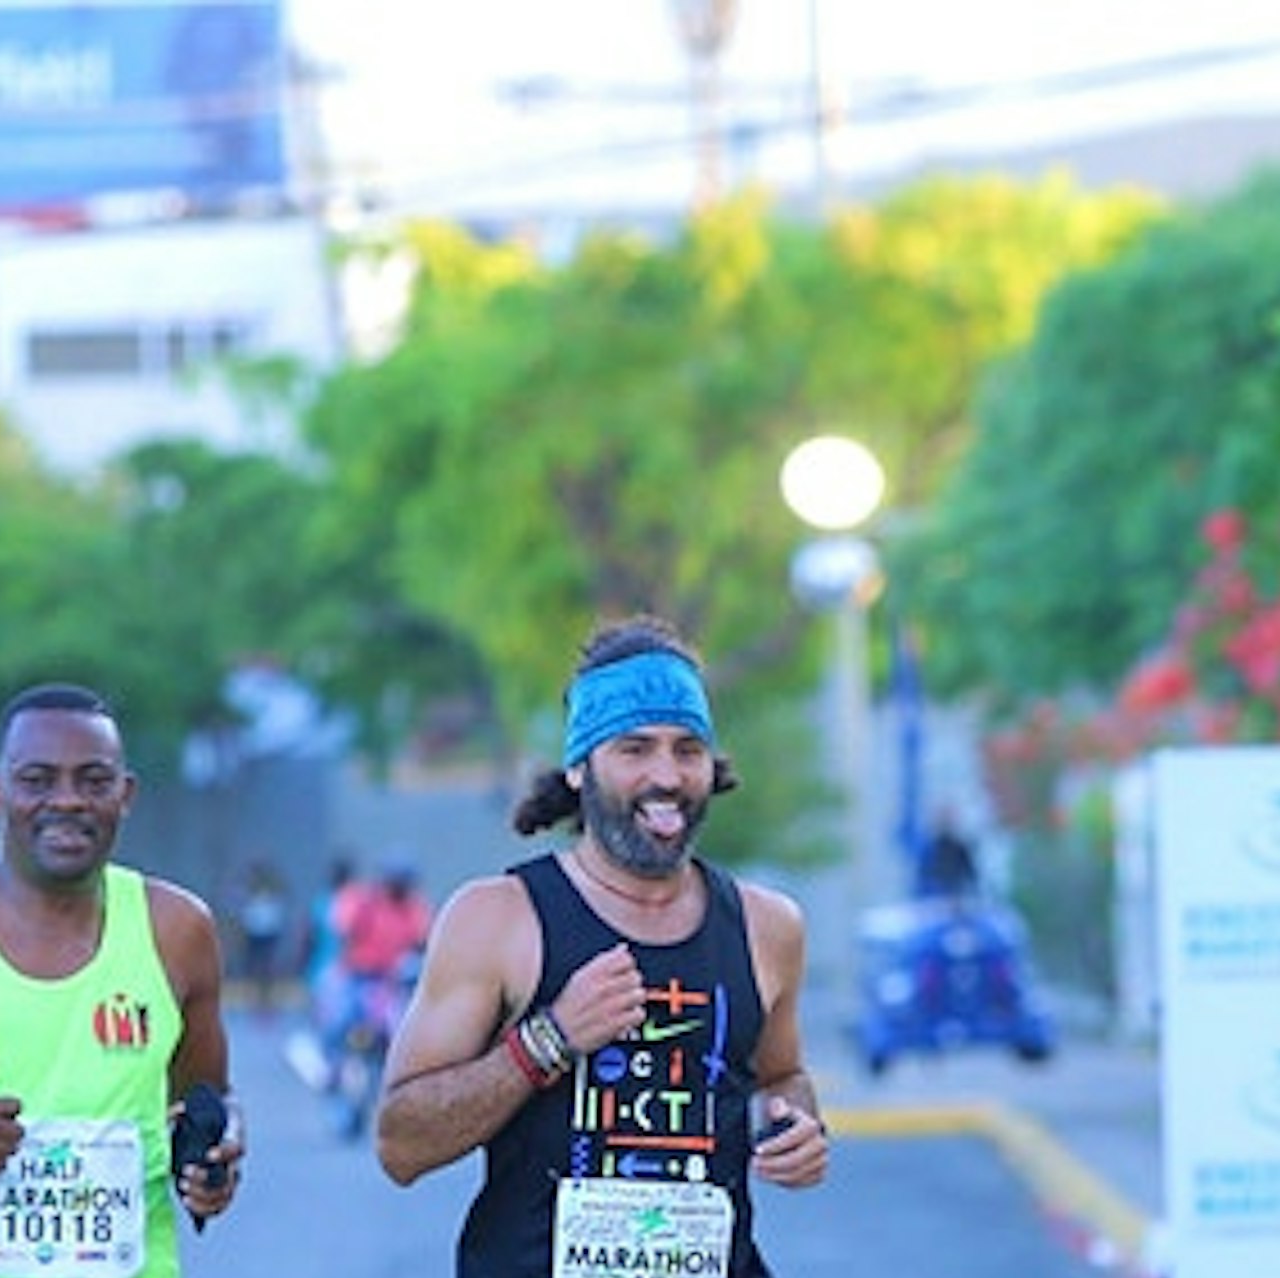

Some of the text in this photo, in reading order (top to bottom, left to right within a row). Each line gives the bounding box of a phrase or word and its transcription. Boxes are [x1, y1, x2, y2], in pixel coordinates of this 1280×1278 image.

[21, 1157, 83, 1181] HALF
[4, 1212, 113, 1244] 10118
[564, 1246, 722, 1276] MARATHON
